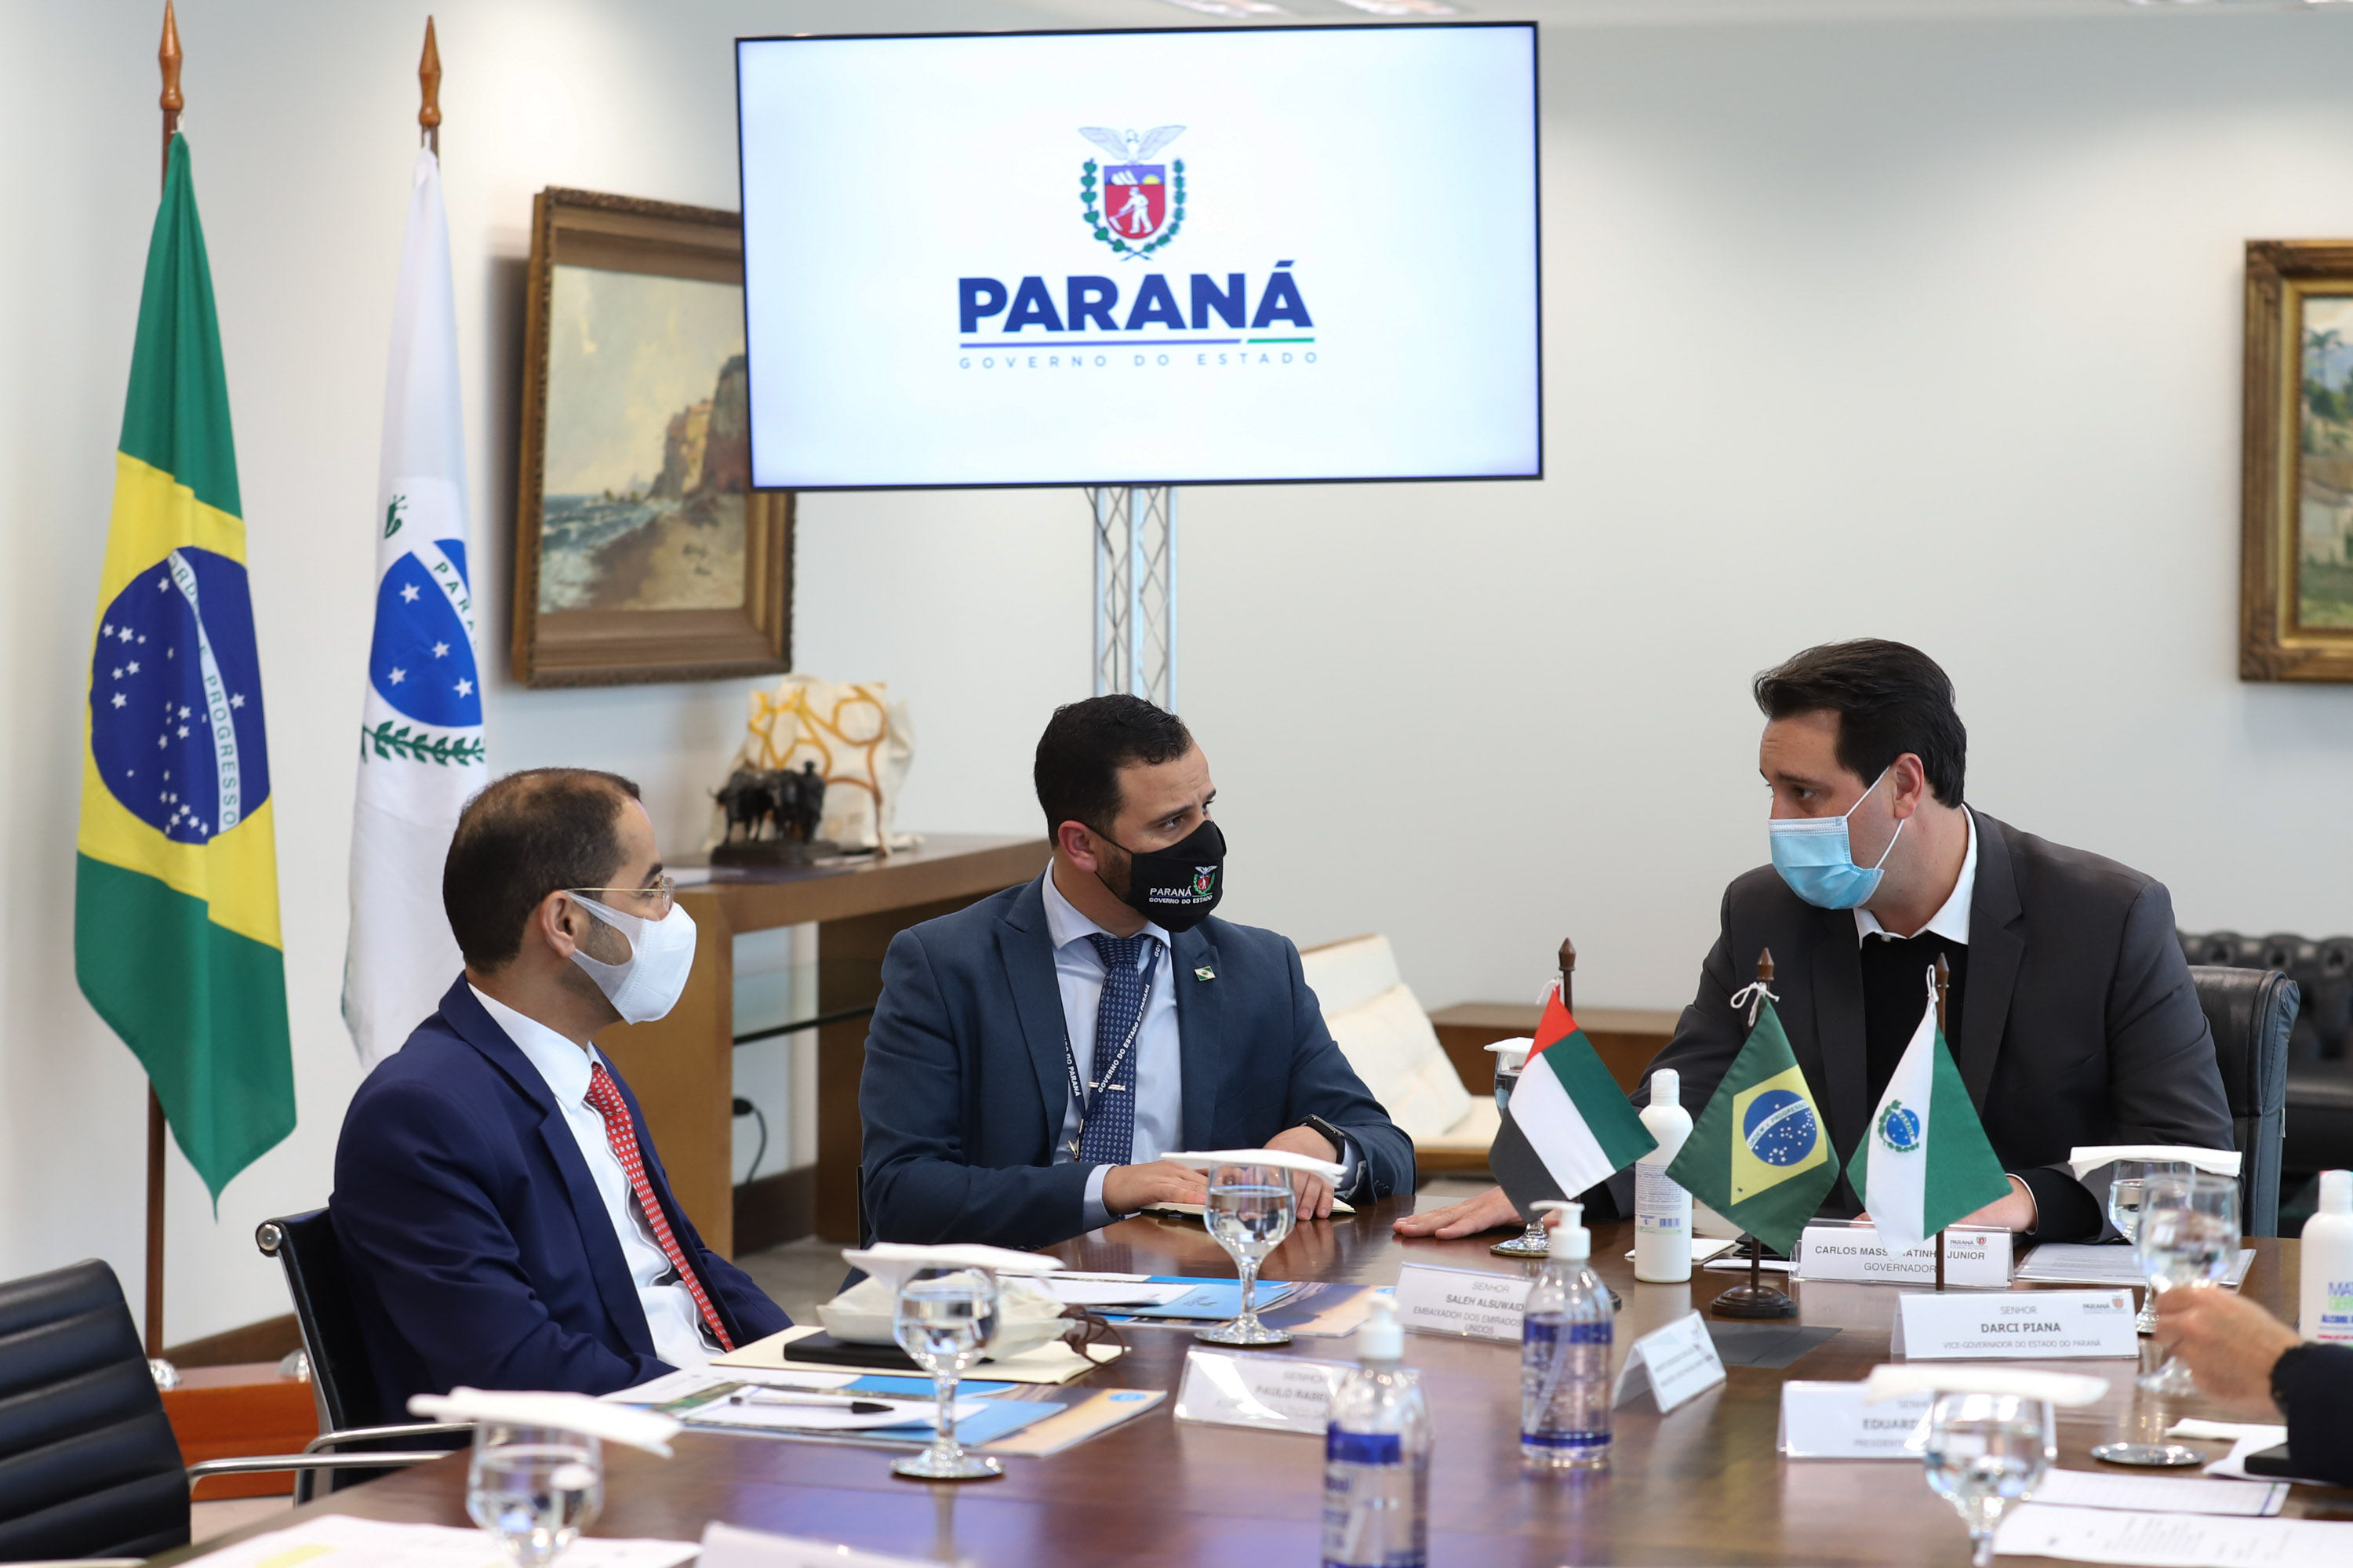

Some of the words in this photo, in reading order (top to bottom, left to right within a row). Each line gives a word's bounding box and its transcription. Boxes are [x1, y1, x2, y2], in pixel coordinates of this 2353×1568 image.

[958, 260, 1315, 333] PARANÁ
[959, 355, 1107, 369] GOVERNO
[1134, 354, 1169, 367] DO
[1197, 351, 1318, 366] ESTADO
[205, 674, 238, 826] PROGRESSO
[1149, 886, 1192, 897] PARANÁ
[1192, 894, 1213, 904] ESTADO
[1098, 1059, 1120, 1093] GOVERNO
[1116, 1048, 1126, 1060] DO
[1122, 1021, 1140, 1049] ESTADO
[1136, 1010, 1143, 1022] DO
[1814, 1246, 1857, 1256] CARLOS
[1859, 1246, 1889, 1257] MASS
[1947, 1251, 1985, 1261] JUNIOR
[1864, 1262, 1937, 1273] GOVERNADOR
[1471, 1281, 1511, 1293] SENHOR
[1446, 1294, 1475, 1306] SALEH
[1413, 1306, 1464, 1320] EMBAIXADOR
[1464, 1313, 1481, 1322] DOS
[2000, 1305, 2038, 1315] SENHOR
[1464, 1323, 1495, 1334] UNIDOS
[1980, 1322, 2020, 1333] DARCI
[2023, 1322, 2061, 1333] PIANA
